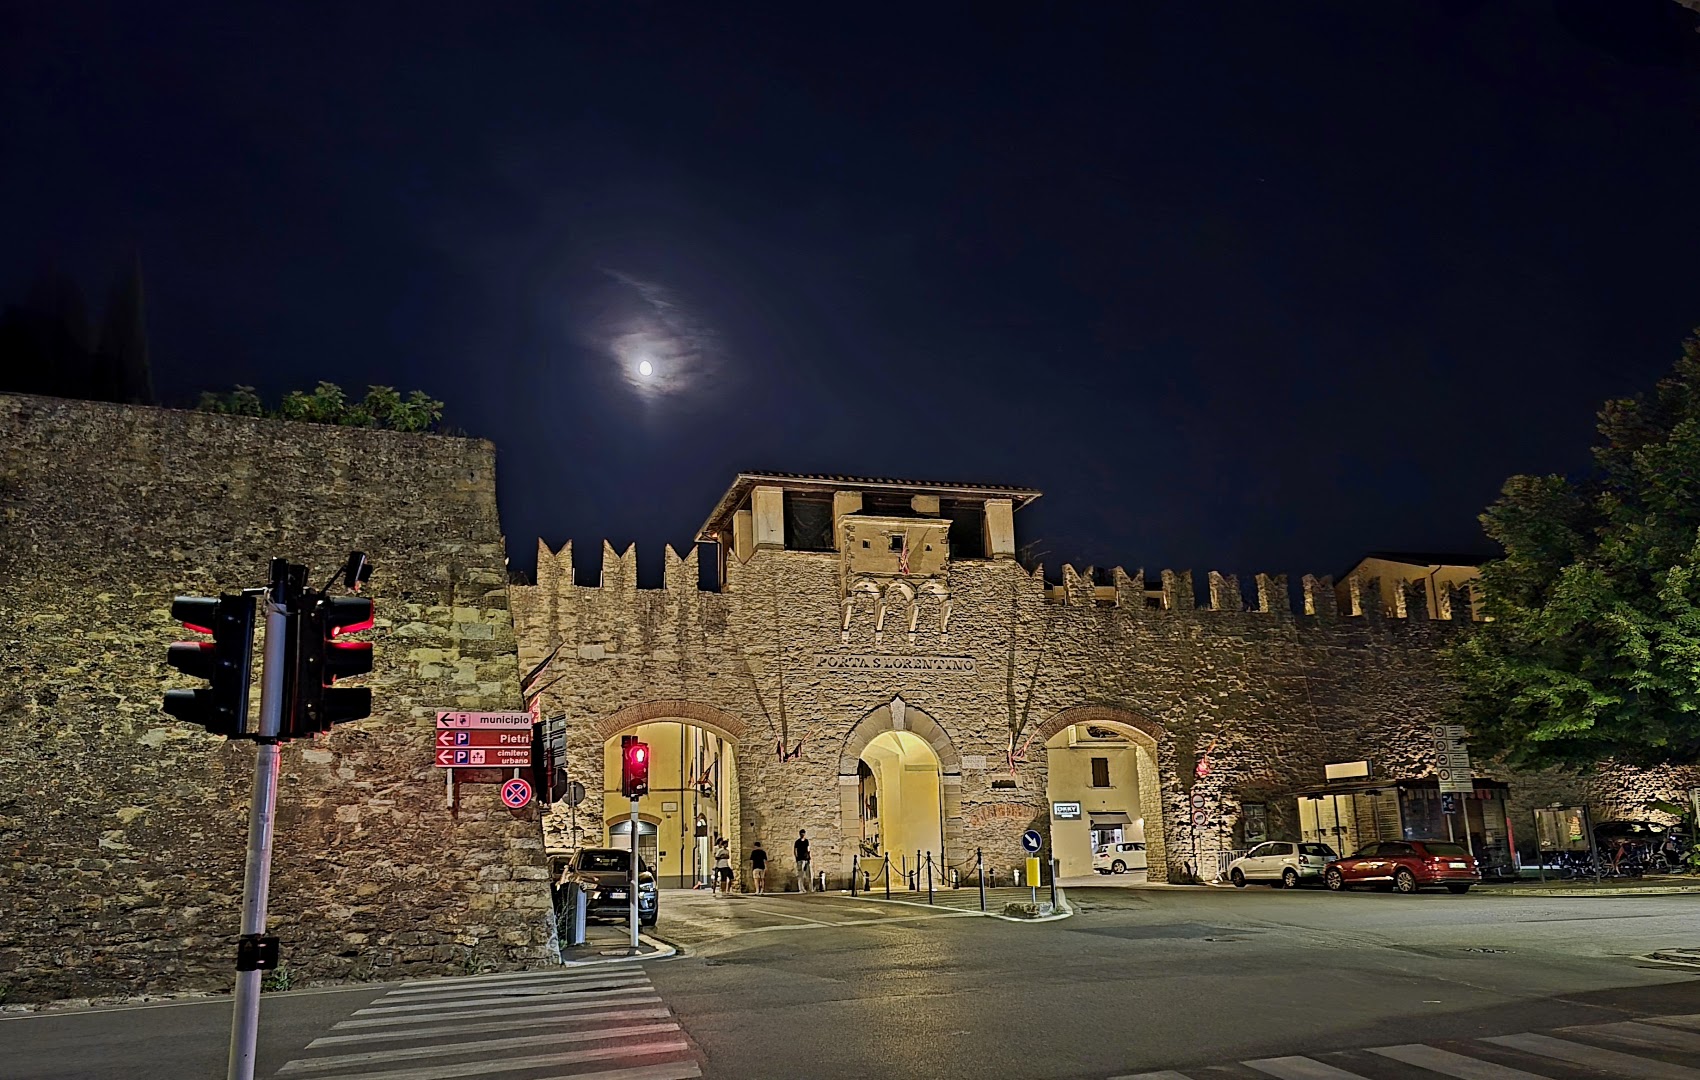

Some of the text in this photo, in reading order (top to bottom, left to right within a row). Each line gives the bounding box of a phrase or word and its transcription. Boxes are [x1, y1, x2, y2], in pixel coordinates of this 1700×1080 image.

[884, 657, 974, 671] LORENTINO
[480, 715, 529, 725] municipio
[458, 733, 529, 744] P Pietri
[457, 751, 466, 762] P
